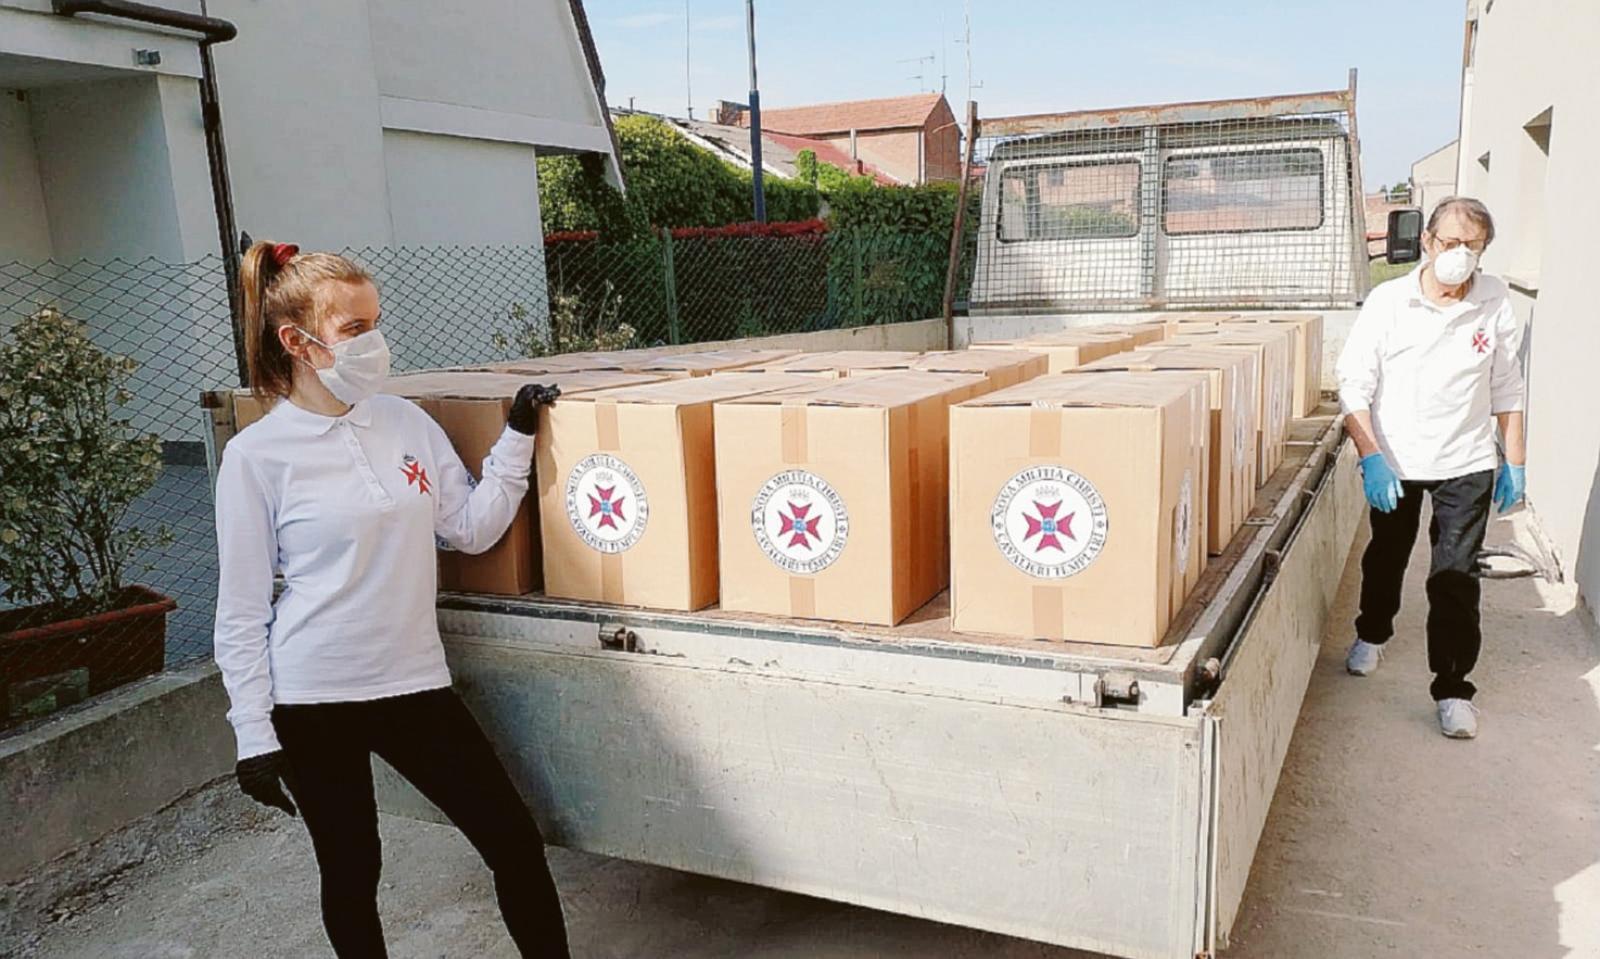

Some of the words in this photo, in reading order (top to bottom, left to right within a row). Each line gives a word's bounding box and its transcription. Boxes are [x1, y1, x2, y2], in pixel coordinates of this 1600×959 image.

[754, 485, 774, 513] NOVA
[772, 471, 814, 486] MILITIA
[815, 479, 846, 522] CHRISTI
[995, 485, 1017, 517] NOVA
[1015, 467, 1064, 487] MILITIA
[1066, 472, 1105, 517] CHRISTI
[801, 536, 845, 571] TEMPLARI
[996, 532, 1051, 576] CAVALIERI
[1052, 531, 1105, 576] TEMPLARI
